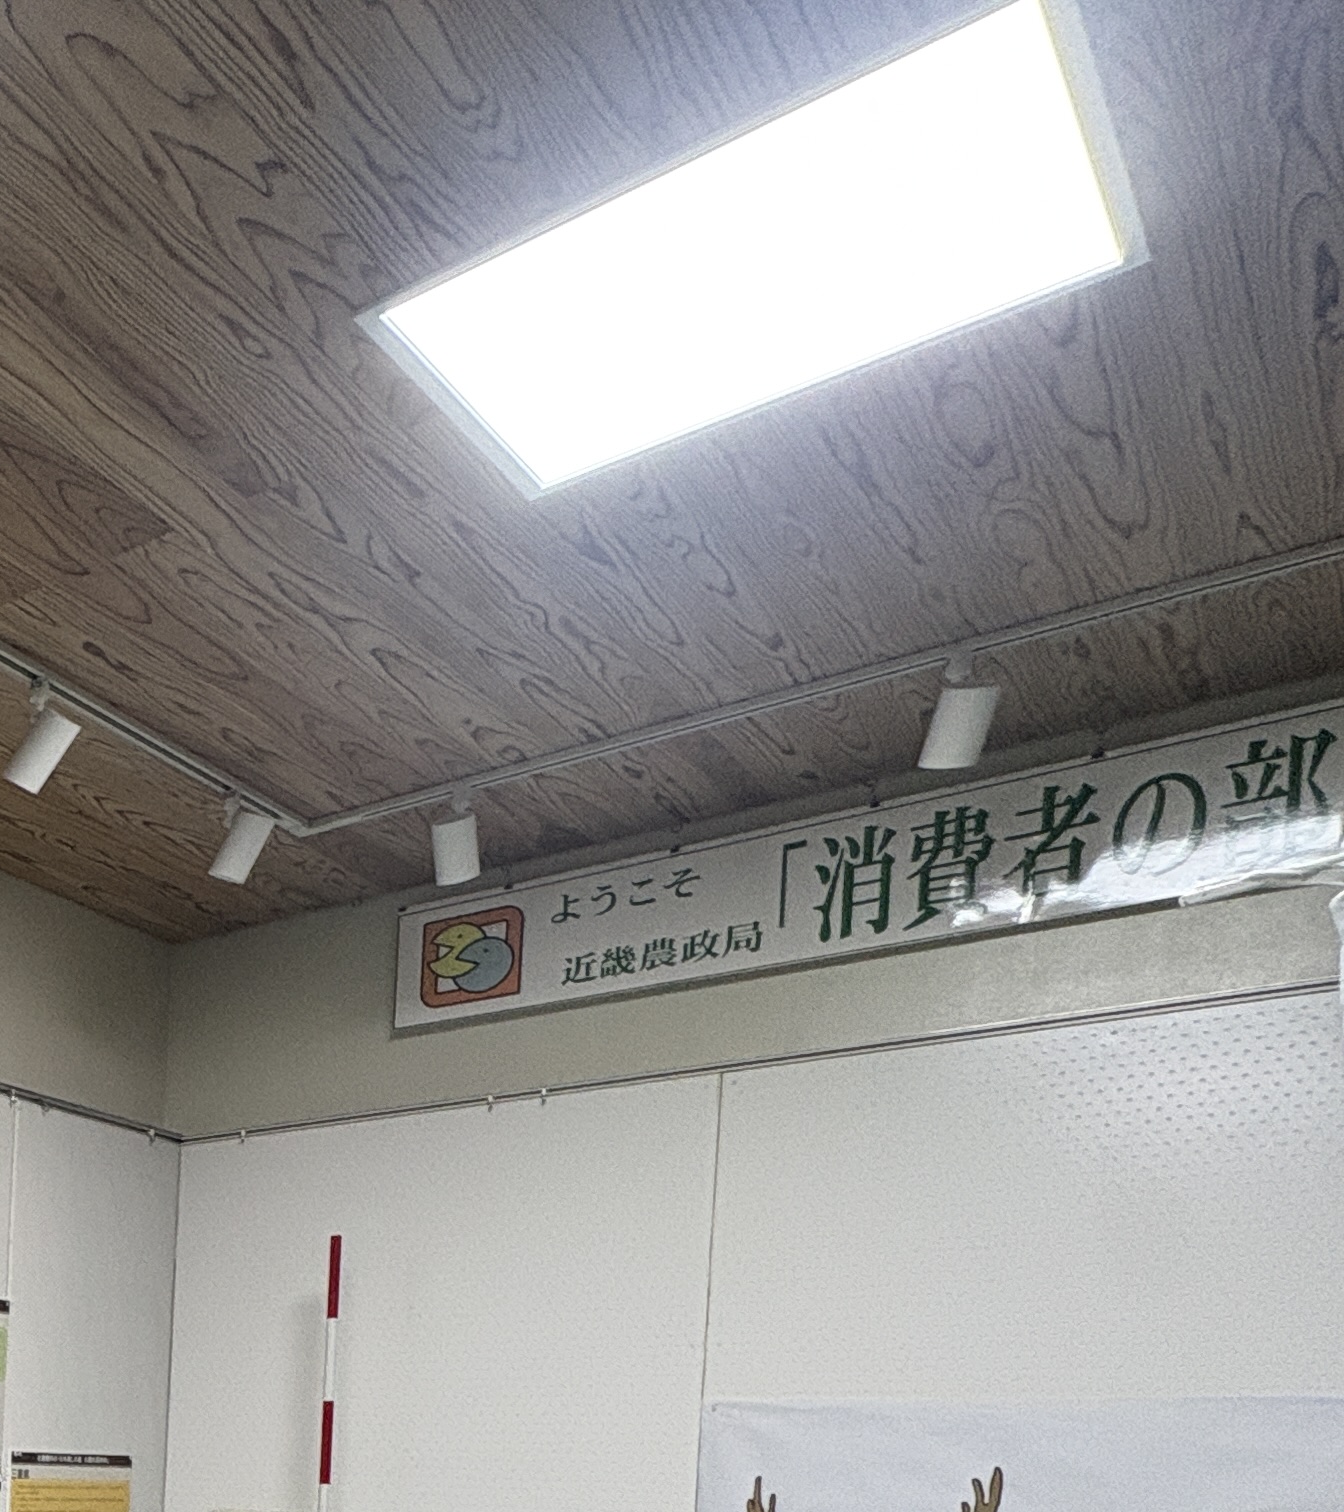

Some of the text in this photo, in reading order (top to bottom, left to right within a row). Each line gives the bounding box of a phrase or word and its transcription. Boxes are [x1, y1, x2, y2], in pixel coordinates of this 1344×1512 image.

[551, 868, 700, 923] ようこそ
[562, 921, 762, 986] 近畿農政局
